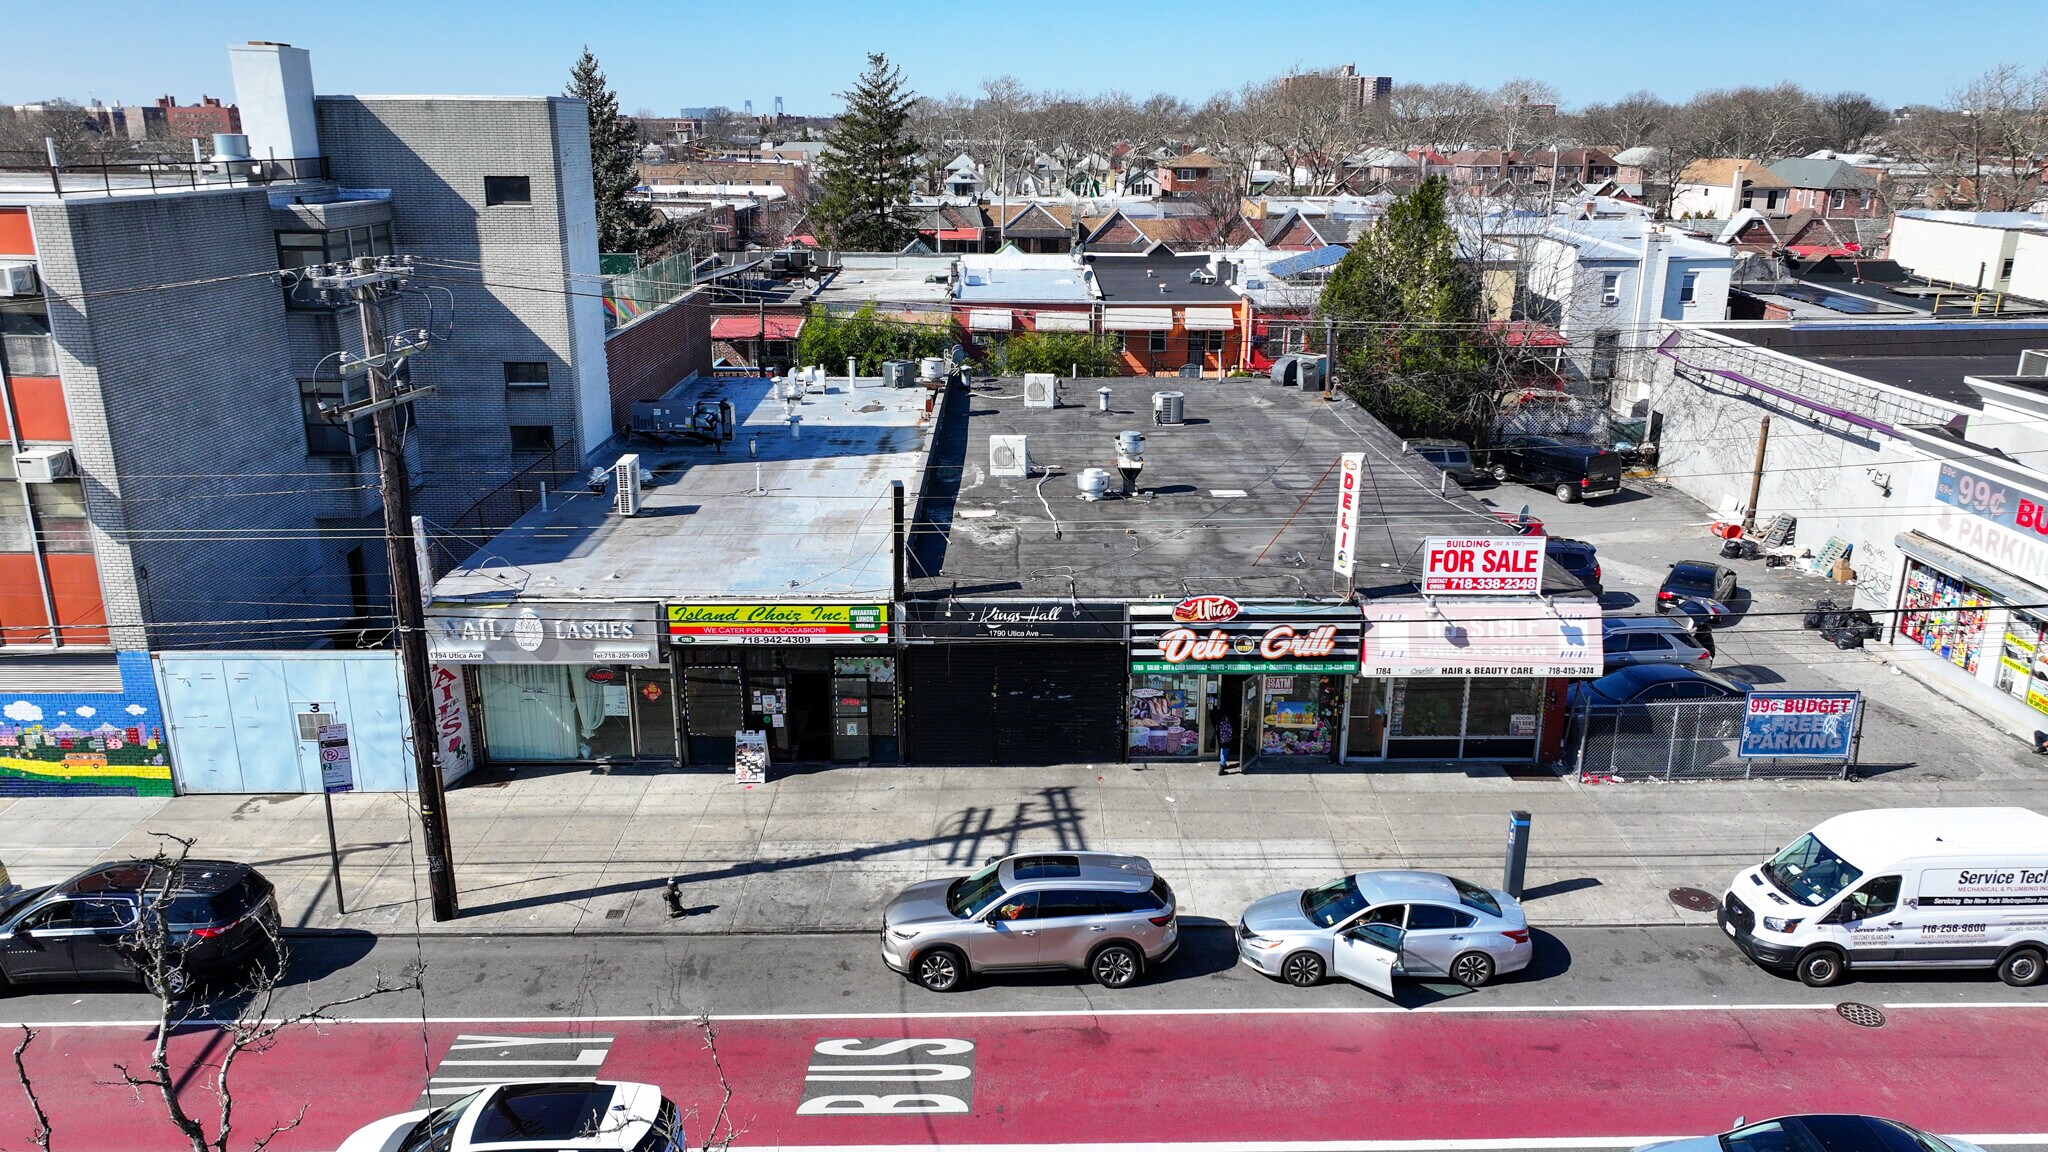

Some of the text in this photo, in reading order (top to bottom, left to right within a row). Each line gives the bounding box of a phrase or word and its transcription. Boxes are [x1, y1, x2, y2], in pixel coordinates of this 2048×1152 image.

[1958, 475, 2006, 520] 99¢
[1340, 471, 1354, 549] DELI
[1446, 540, 1491, 548] BUILDING
[1958, 516, 2048, 577] PARKIN
[1429, 549, 1539, 573] FOR SALE
[1450, 578, 1536, 589] 718-338-2348
[674, 606, 740, 622] Island
[810, 606, 847, 622] Inc.
[1196, 599, 1233, 620] Utica
[967, 606, 1063, 629] 3 Kings Hall
[441, 618, 634, 641] NAIL LASHES
[779, 626, 826, 634] OCCASIONS
[740, 636, 811, 644] 718-942-4309
[1159, 624, 1338, 663] Deli Grill
[430, 652, 448, 660] 1794
[449, 652, 466, 660] Utica
[593, 652, 649, 660] Tel:718-209-0089
[1486, 645, 1546, 656] SALON
[588, 670, 616, 681] Nails
[1375, 667, 1391, 675] 1784
[1441, 667, 1463, 675] HAIR
[1465, 667, 1472, 675] &
[1474, 667, 1508, 675] BEAUTY
[1510, 667, 1534, 675] CARE
[1548, 667, 1594, 675] 718-415-7474
[1275, 678, 1291, 689] ATM
[309, 703, 320, 713] 3
[431, 663, 463, 739] AILS
[841, 697, 860, 706] OPEN
[1783, 698, 1851, 713] BUDGET
[848, 725, 856, 733] A
[1771, 715, 1823, 732] FREE
[1747, 733, 1842, 749] PARKING
[1958, 869, 2015, 885] Service
[1933, 897, 1961, 906] Servicing
[2001, 896, 2038, 906] Metropolitan
[796, 1038, 975, 1115] BUS
